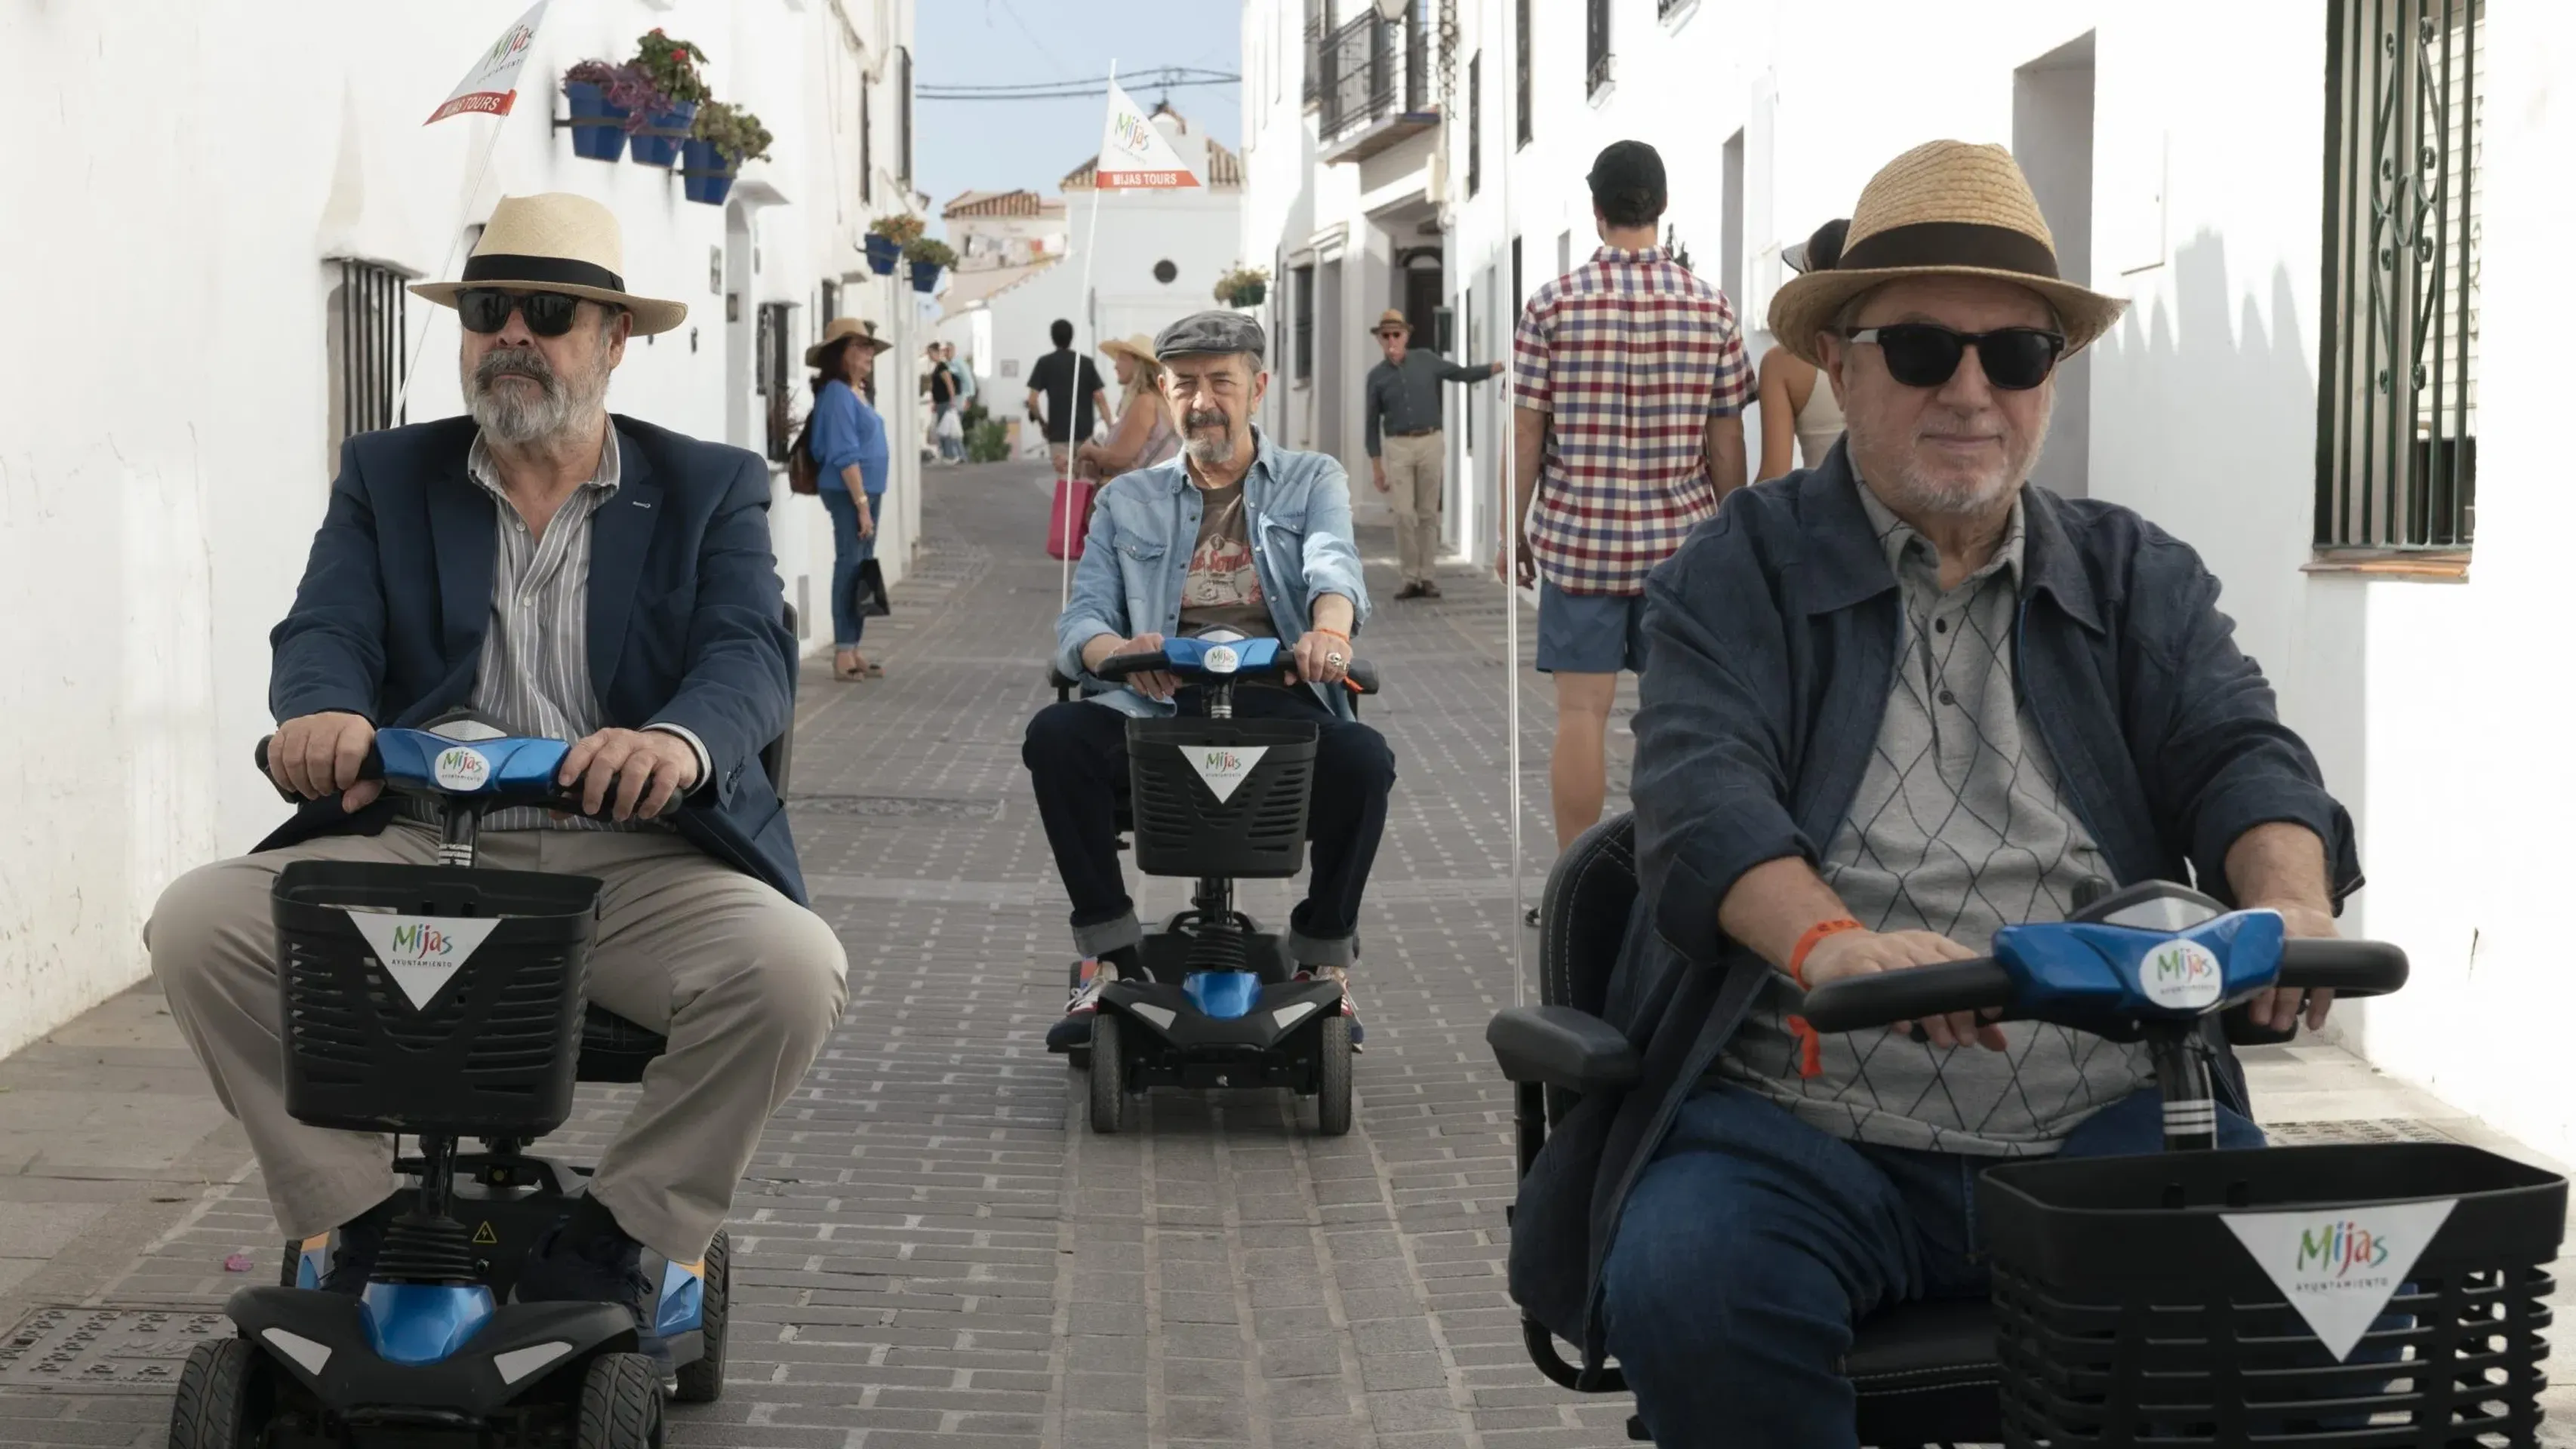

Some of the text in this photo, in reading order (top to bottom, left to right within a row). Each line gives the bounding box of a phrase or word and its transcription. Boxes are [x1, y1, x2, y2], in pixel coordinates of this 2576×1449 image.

[463, 96, 500, 111] TOURS
[1114, 112, 1150, 151] Mijas
[1113, 173, 1177, 185] MIJAS TOURS
[1211, 648, 1236, 663] Mijas
[442, 750, 483, 774] Mijas
[1205, 751, 1242, 772] Mijas
[392, 923, 453, 959] Mijas
[392, 958, 452, 968] AYUNTAMIENTO
[2157, 948, 2214, 983] Mijas
[2297, 1220, 2389, 1278] Mijas
[2295, 1276, 2389, 1292] AYUNTAMIENTO
